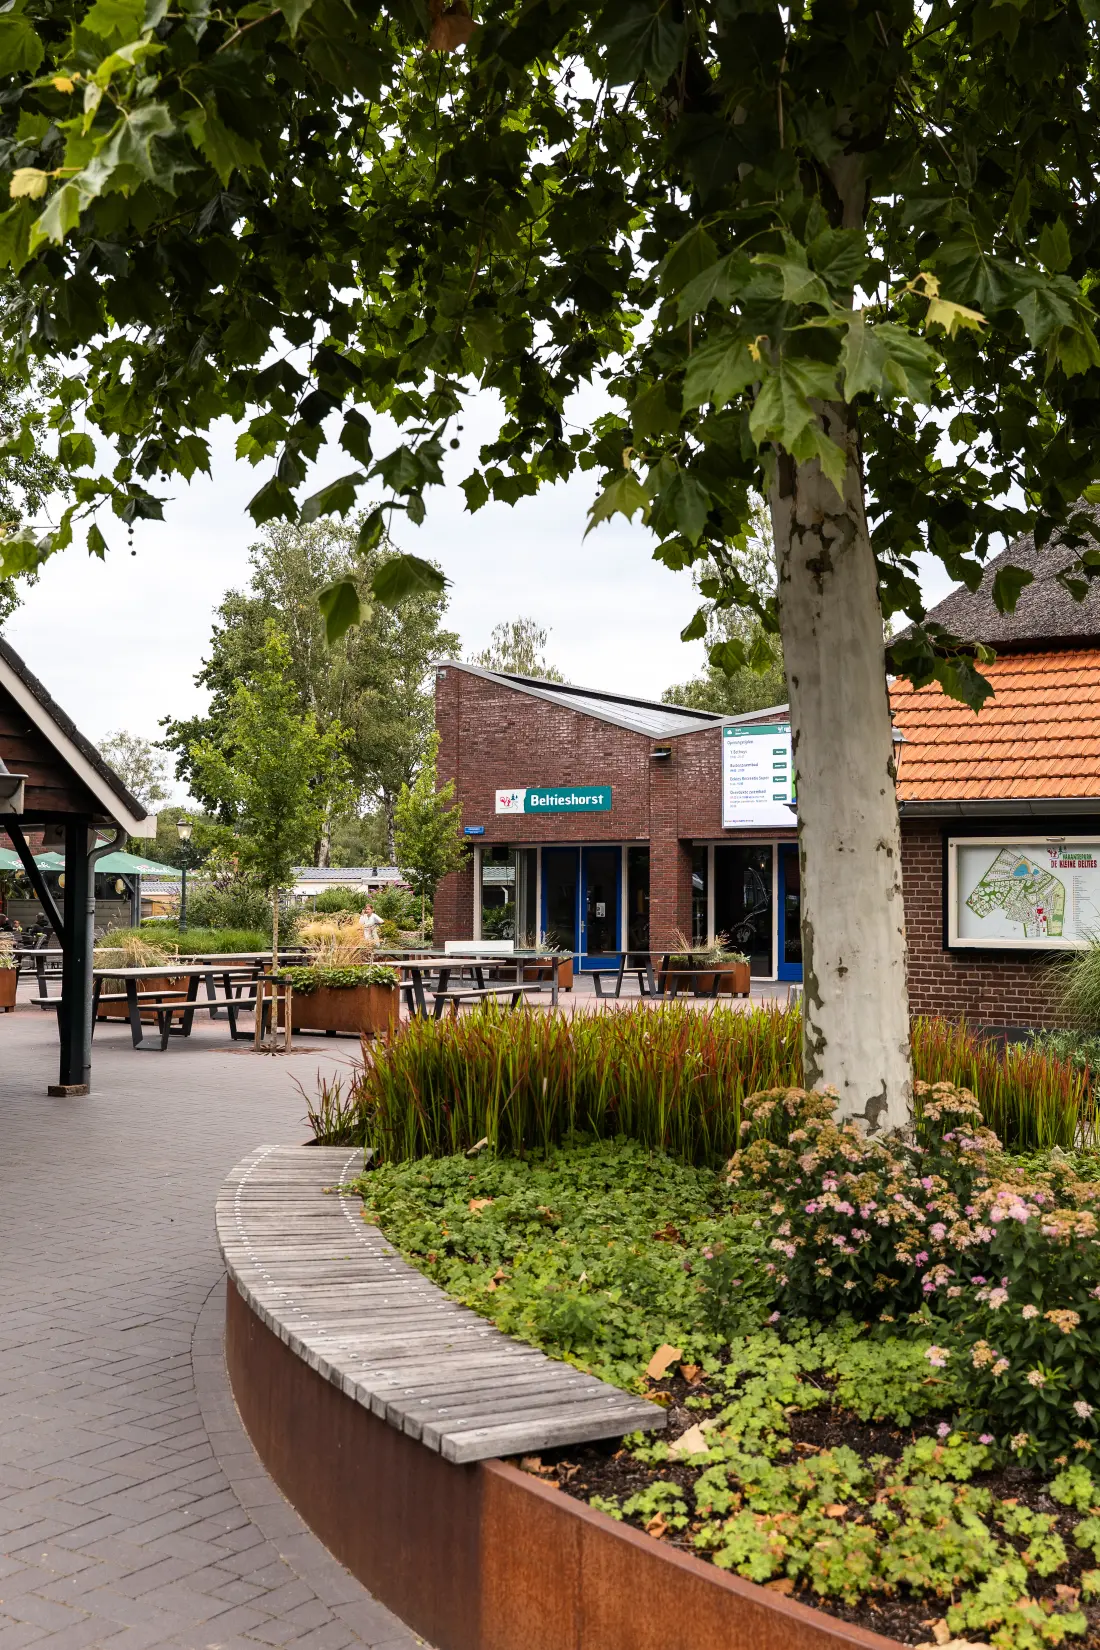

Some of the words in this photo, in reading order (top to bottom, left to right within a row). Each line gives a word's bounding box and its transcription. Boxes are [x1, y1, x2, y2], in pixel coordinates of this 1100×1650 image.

[530, 793, 604, 807] Beltieshorst
[1050, 860, 1058, 868] DE
[1059, 860, 1076, 868] KLEINE
